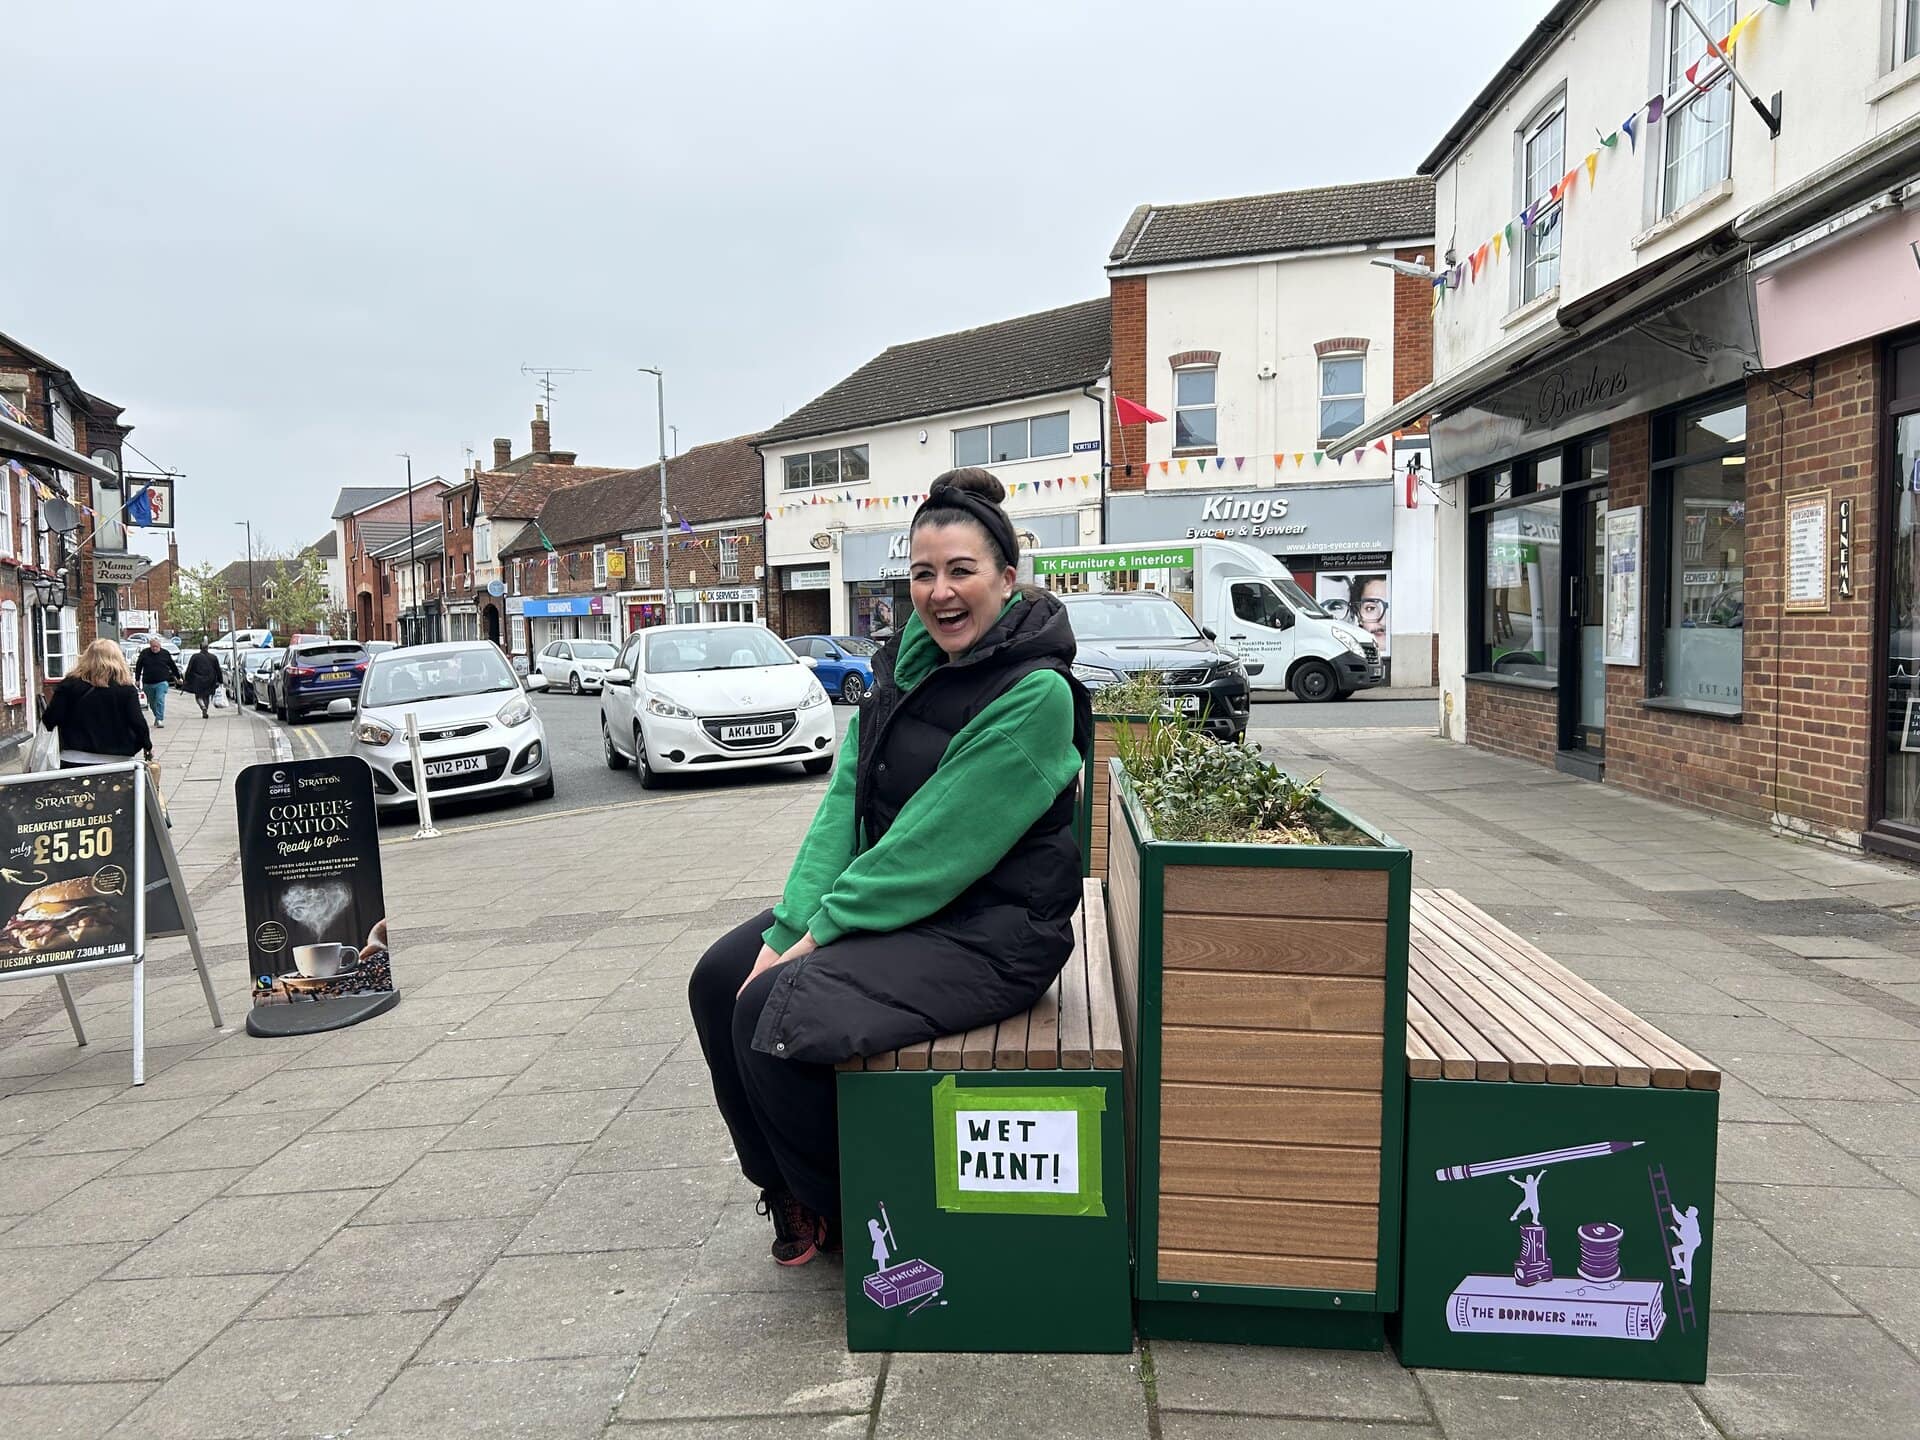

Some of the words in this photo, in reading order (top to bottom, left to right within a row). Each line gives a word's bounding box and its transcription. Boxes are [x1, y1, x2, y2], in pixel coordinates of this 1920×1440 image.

[1538, 362, 1628, 424] Barbers
[1092, 441, 1098, 449] ST
[1202, 496, 1289, 523] Kings
[1238, 527, 1249, 537] &
[1252, 524, 1308, 538] Eyewear
[1286, 541, 1382, 552] www.kings-eyecare.co.uk
[1840, 502, 1849, 595] CINEMA
[98, 560, 133, 571] Mama
[1042, 560, 1057, 570] TK
[1061, 557, 1115, 570] Furniture
[1118, 556, 1127, 567] &
[1131, 554, 1184, 566] Interiors
[97, 570, 133, 580] Rosa's
[716, 591, 739, 600] SERVICES
[728, 726, 752, 738] AK14
[754, 724, 776, 736] UUB
[425, 762, 453, 776] CV12
[455, 758, 479, 772] PDX
[269, 787, 291, 795] COFFEE
[298, 776, 341, 788] STRATTON
[35, 791, 96, 810] STRATTON
[269, 800, 344, 821] COFFEE
[17, 820, 63, 834] BREAKFAST
[65, 817, 87, 829] MEAL
[88, 814, 113, 826] DEALS
[266, 815, 349, 837] STATION
[10, 841, 32, 858] only
[33, 827, 113, 865] £5.50
[277, 839, 312, 857] Ready
[314, 836, 325, 847] to
[0, 949, 76, 969] TUESDAY-SATURDAY
[76, 943, 126, 958] 7.30AM-11AM
[968, 1119, 1036, 1142] WET
[960, 1150, 1060, 1184] PAINT!
[888, 1264, 927, 1283] MATCHES
[1471, 1306, 1494, 1319] THE
[1498, 1308, 1566, 1323] BORROWERS
[1571, 1319, 1597, 1328] NORTON
[1640, 1314, 1649, 1332] 1961
